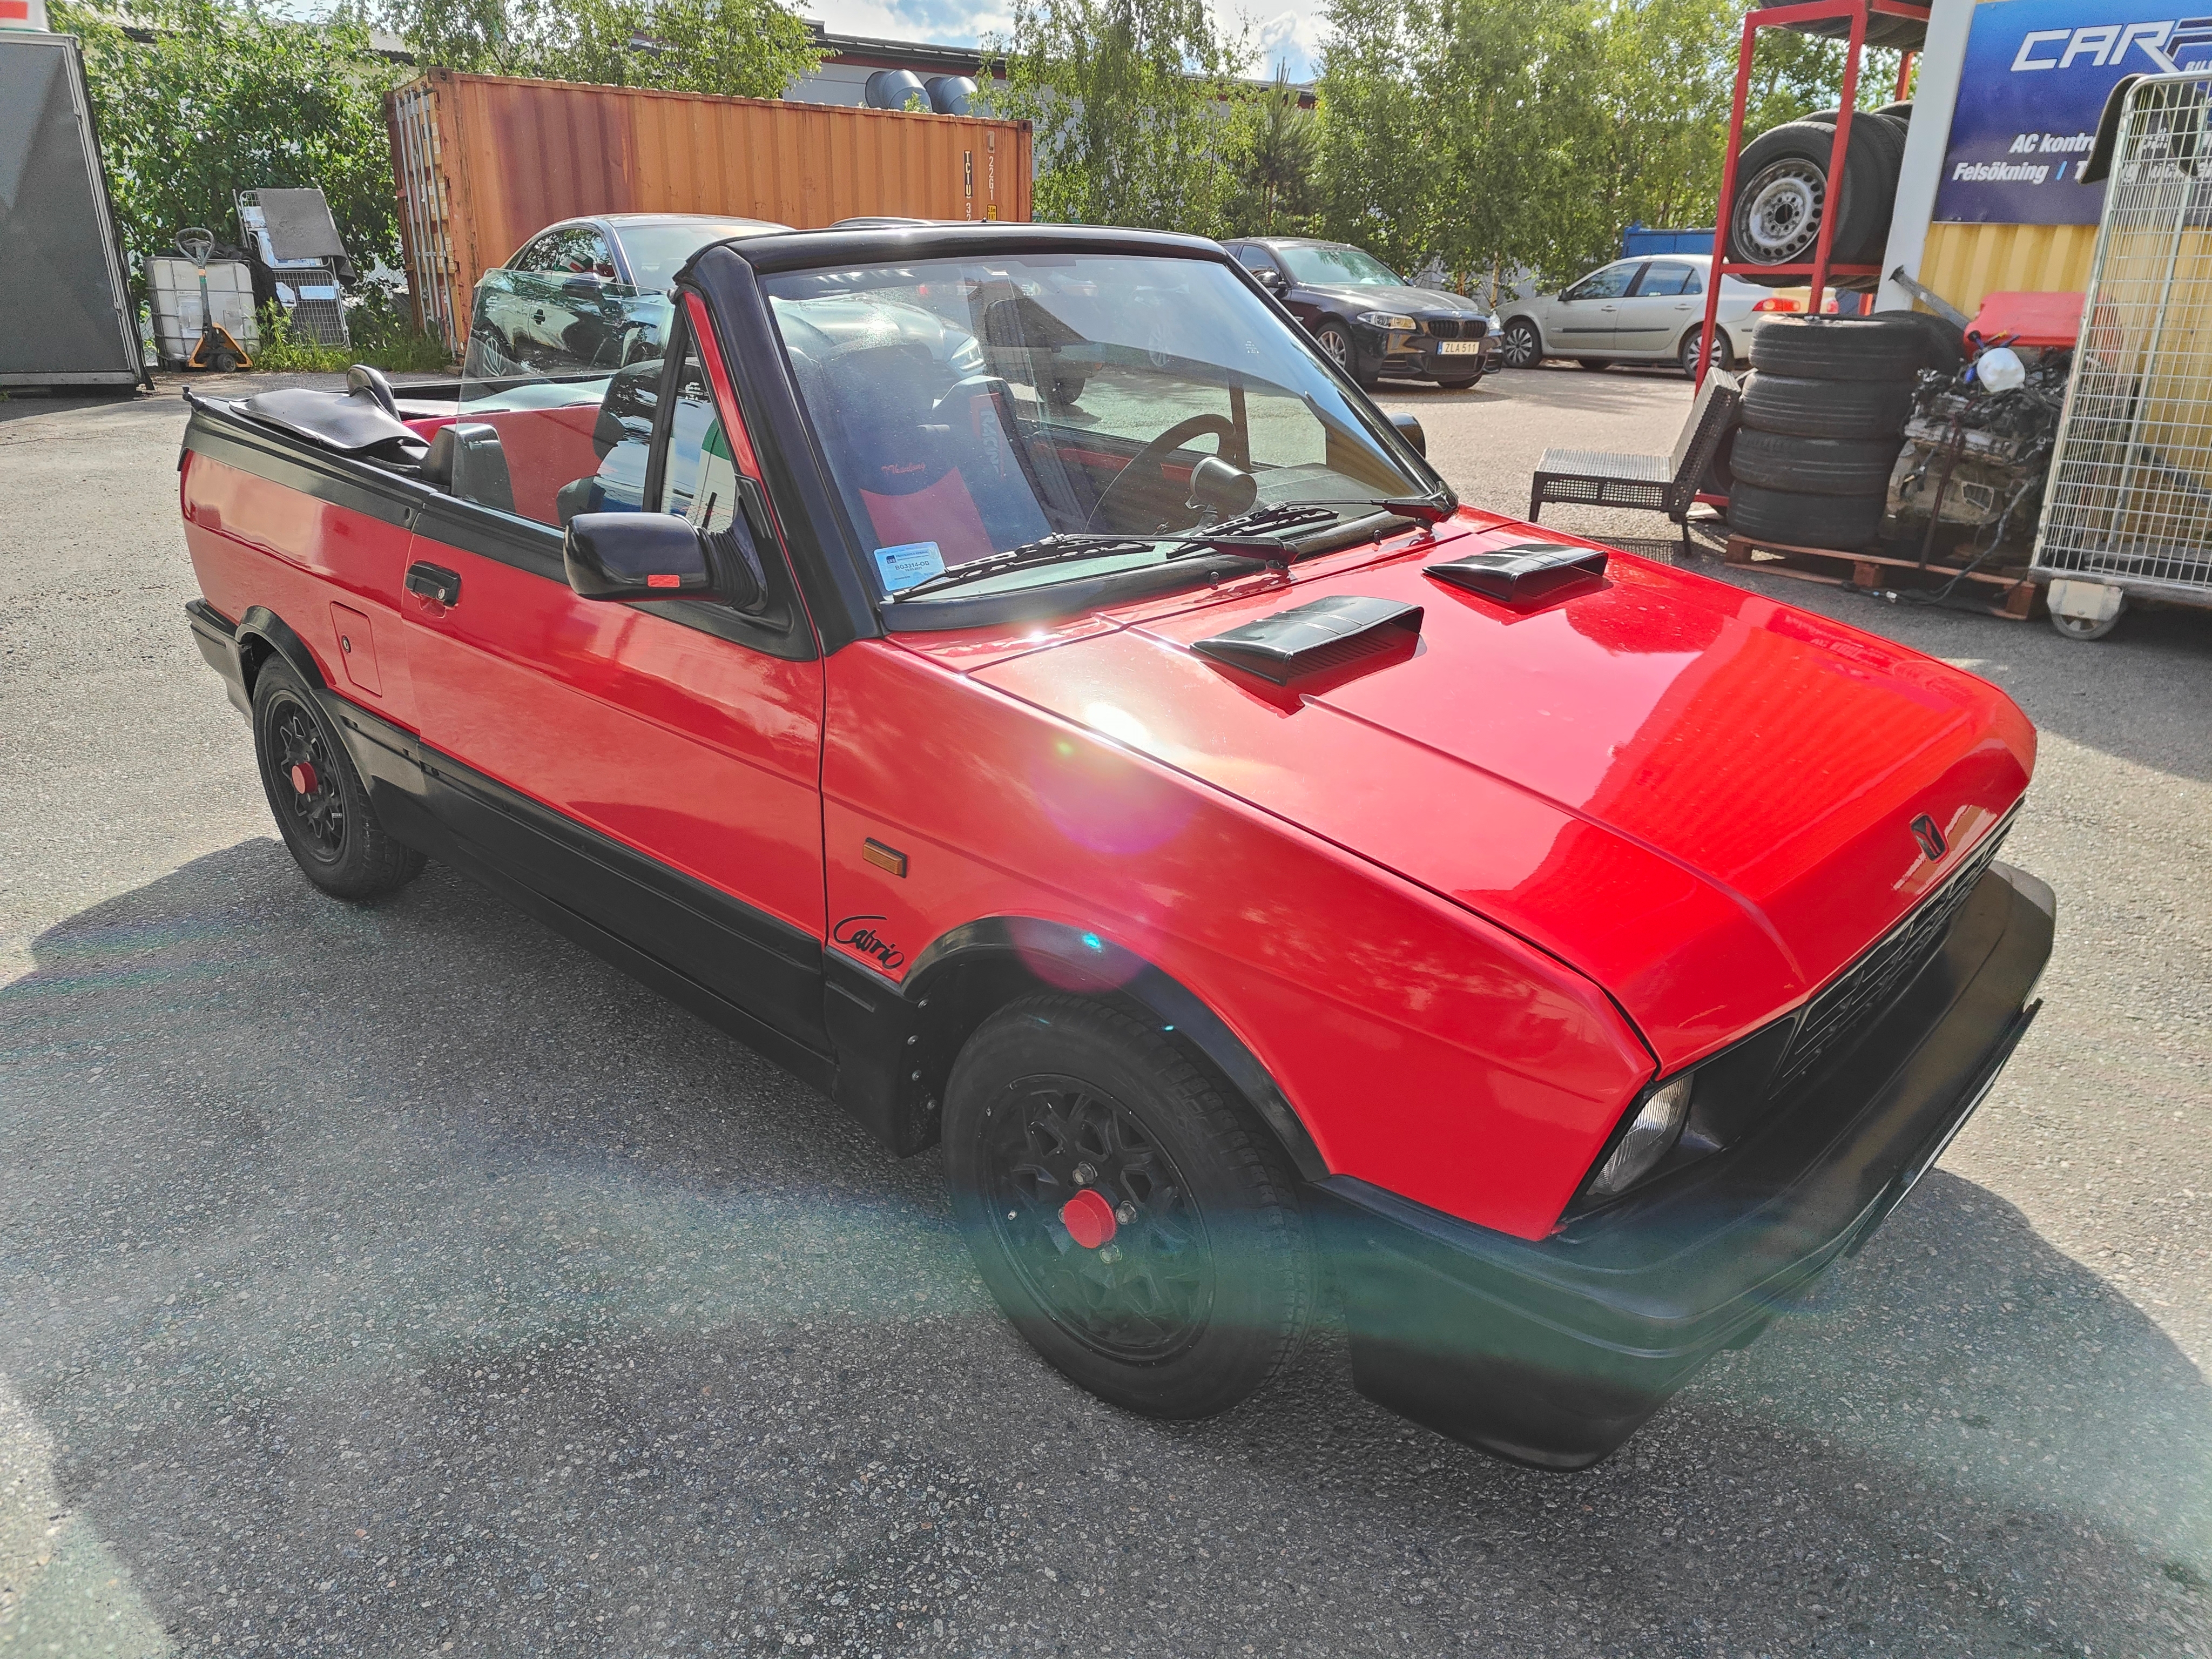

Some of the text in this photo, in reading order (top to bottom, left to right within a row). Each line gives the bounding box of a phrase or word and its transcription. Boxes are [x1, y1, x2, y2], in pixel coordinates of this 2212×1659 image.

[2008, 133, 2039, 153] AC
[1952, 161, 2050, 185] Felsökning
[1445, 343, 1476, 353] ZLA 511
[895, 561, 930, 570] BG3314-OB
[833, 915, 905, 969] Cabrio
